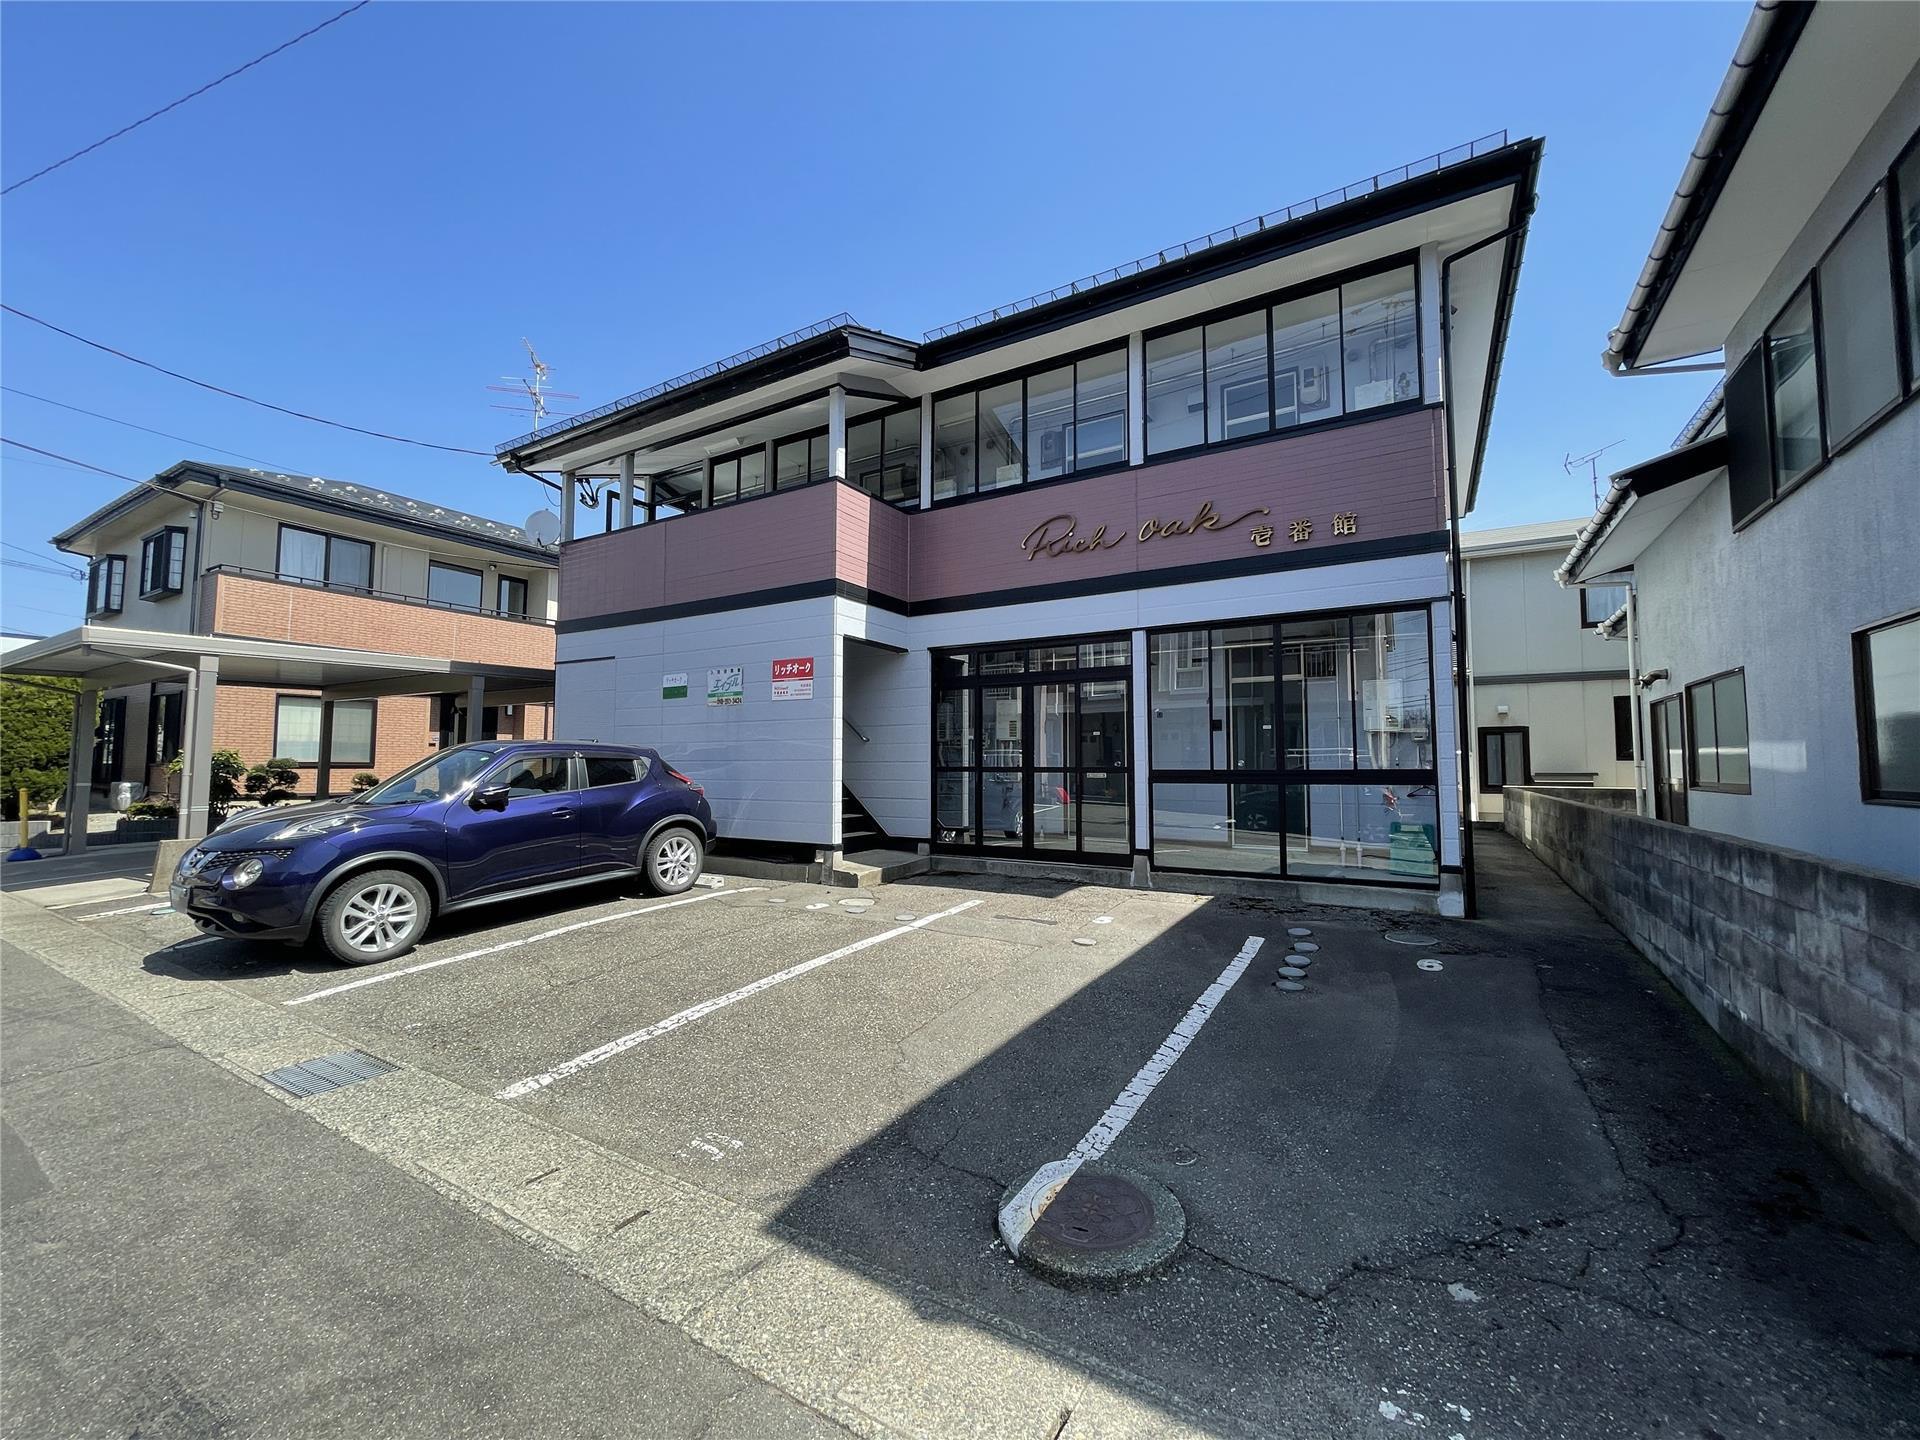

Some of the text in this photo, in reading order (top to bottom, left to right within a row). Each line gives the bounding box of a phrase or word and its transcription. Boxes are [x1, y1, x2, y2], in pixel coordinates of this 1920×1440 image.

[1021, 501, 1270, 561] Rich oak
[1250, 512, 1358, 547] 壱番館
[774, 662, 811, 675] リッチオーク
